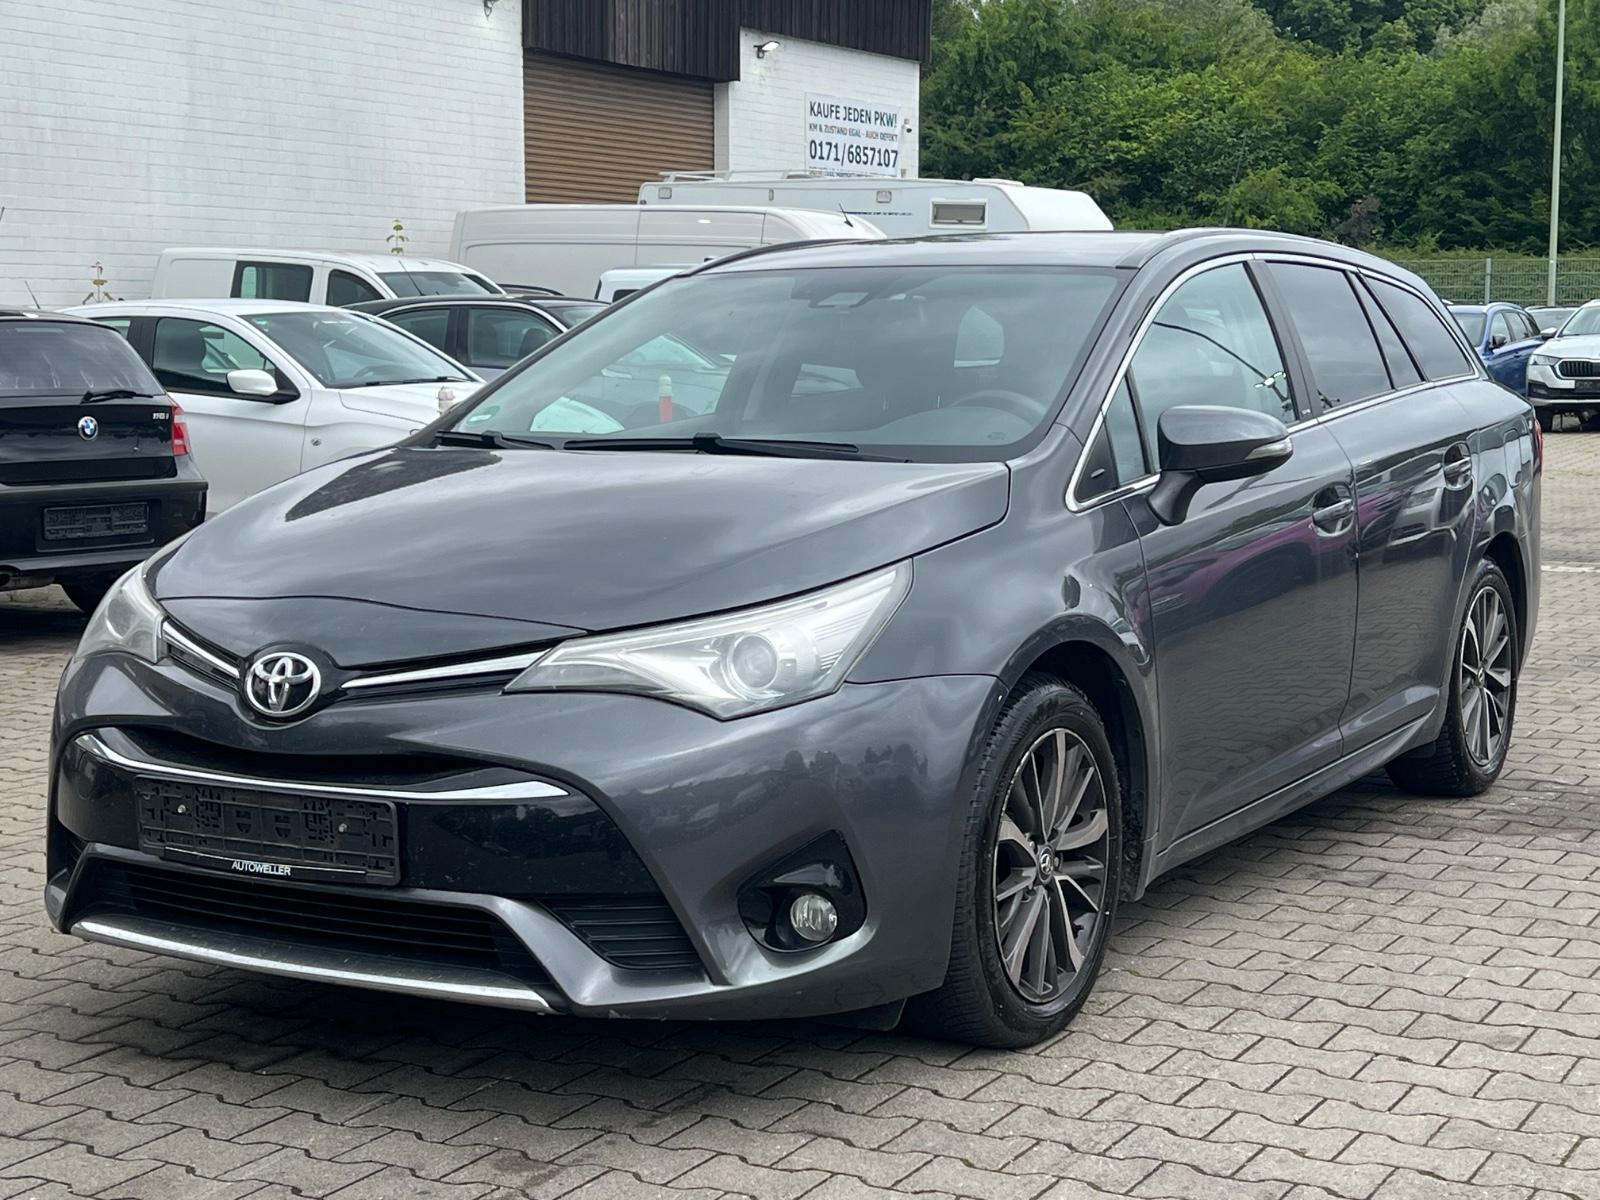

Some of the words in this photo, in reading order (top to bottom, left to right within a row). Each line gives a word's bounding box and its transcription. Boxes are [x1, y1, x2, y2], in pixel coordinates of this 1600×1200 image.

[809, 101, 840, 120] KAUFE
[843, 106, 872, 124] JEDEN
[874, 111, 897, 128] PKW!
[809, 123, 818, 132] KM
[824, 125, 848, 136] ZUSTAND
[848, 128, 861, 137] EGAL
[809, 139, 898, 168] 0171/6857107
[231, 860, 291, 876] AUTOWELLER
